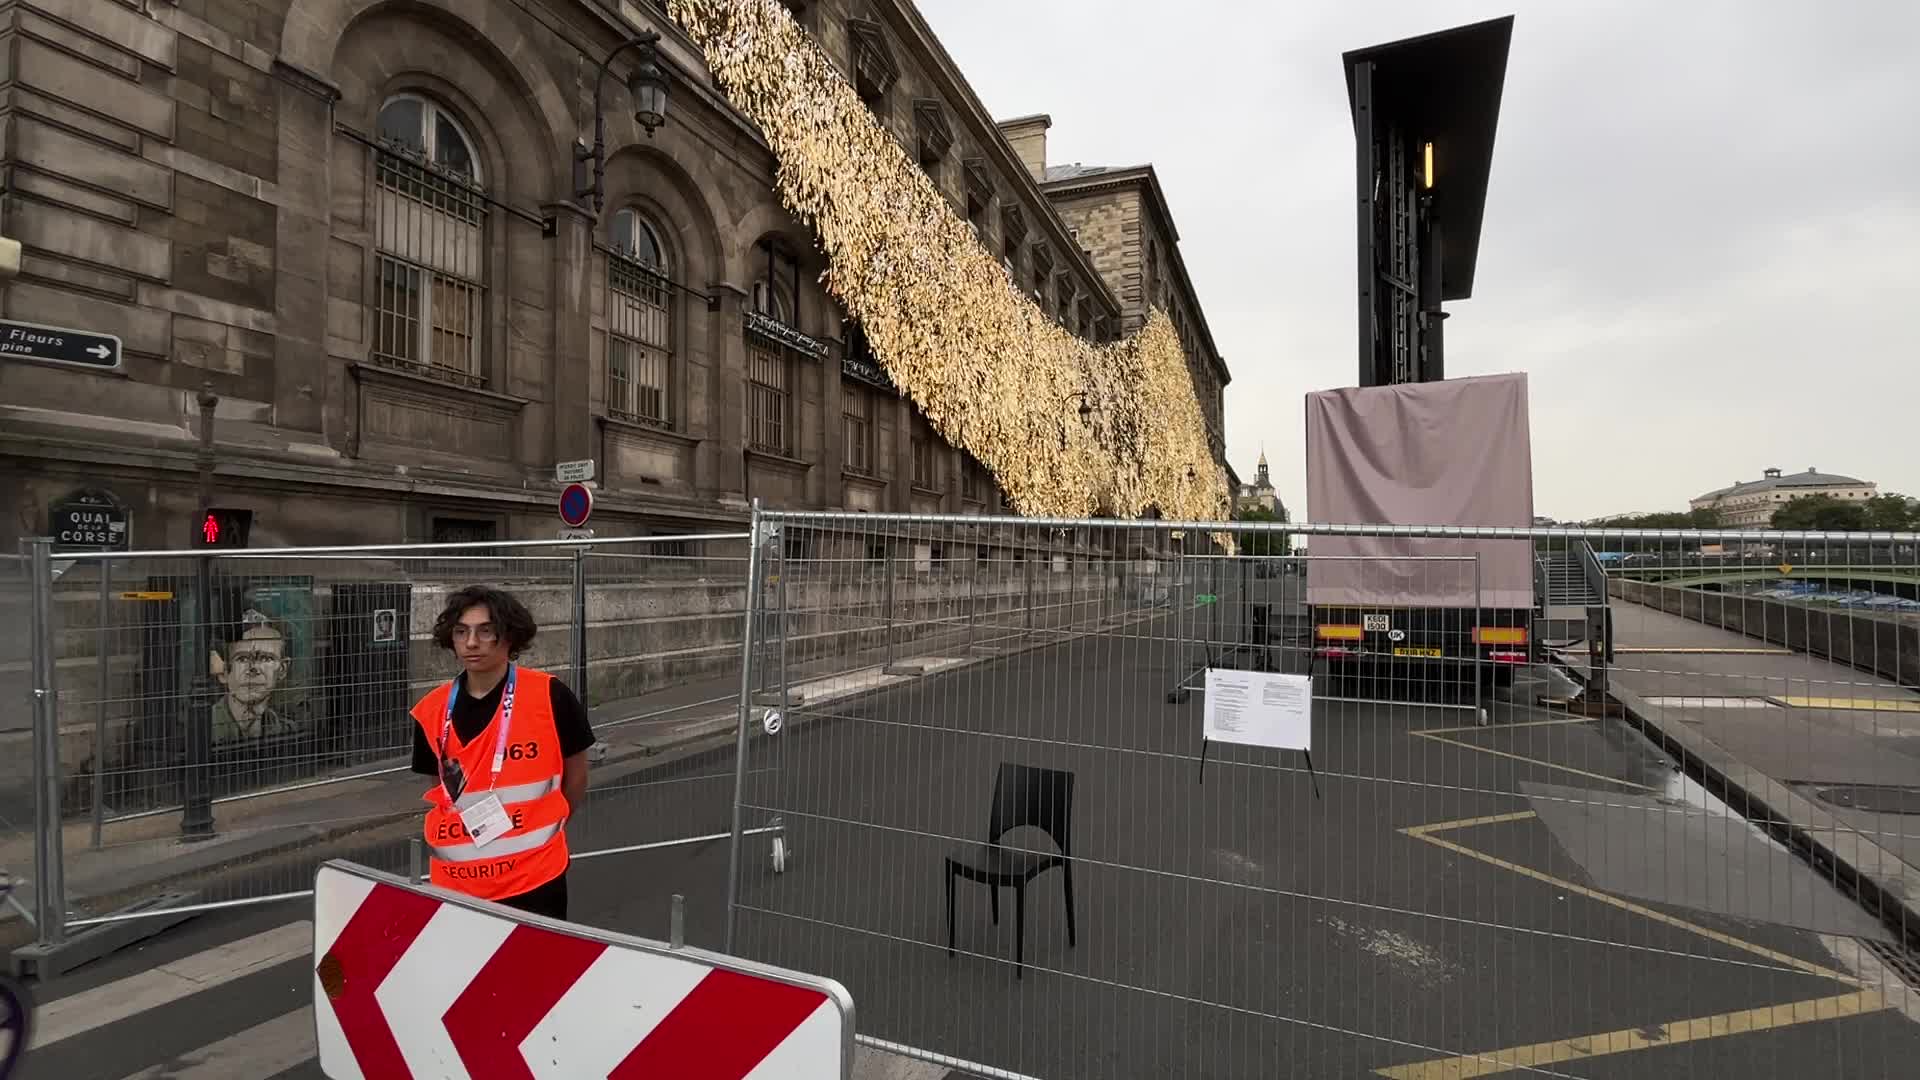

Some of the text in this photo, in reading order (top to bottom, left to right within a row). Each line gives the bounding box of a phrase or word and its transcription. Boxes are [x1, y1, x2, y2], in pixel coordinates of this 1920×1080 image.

[9, 329, 64, 346] Fleurs
[0, 342, 32, 353] pine
[70, 512, 109, 524] QUAI
[61, 530, 117, 543] CORSE
[1390, 631, 1402, 640] UK
[503, 742, 538, 761] 63
[441, 858, 517, 880] SECURITY
